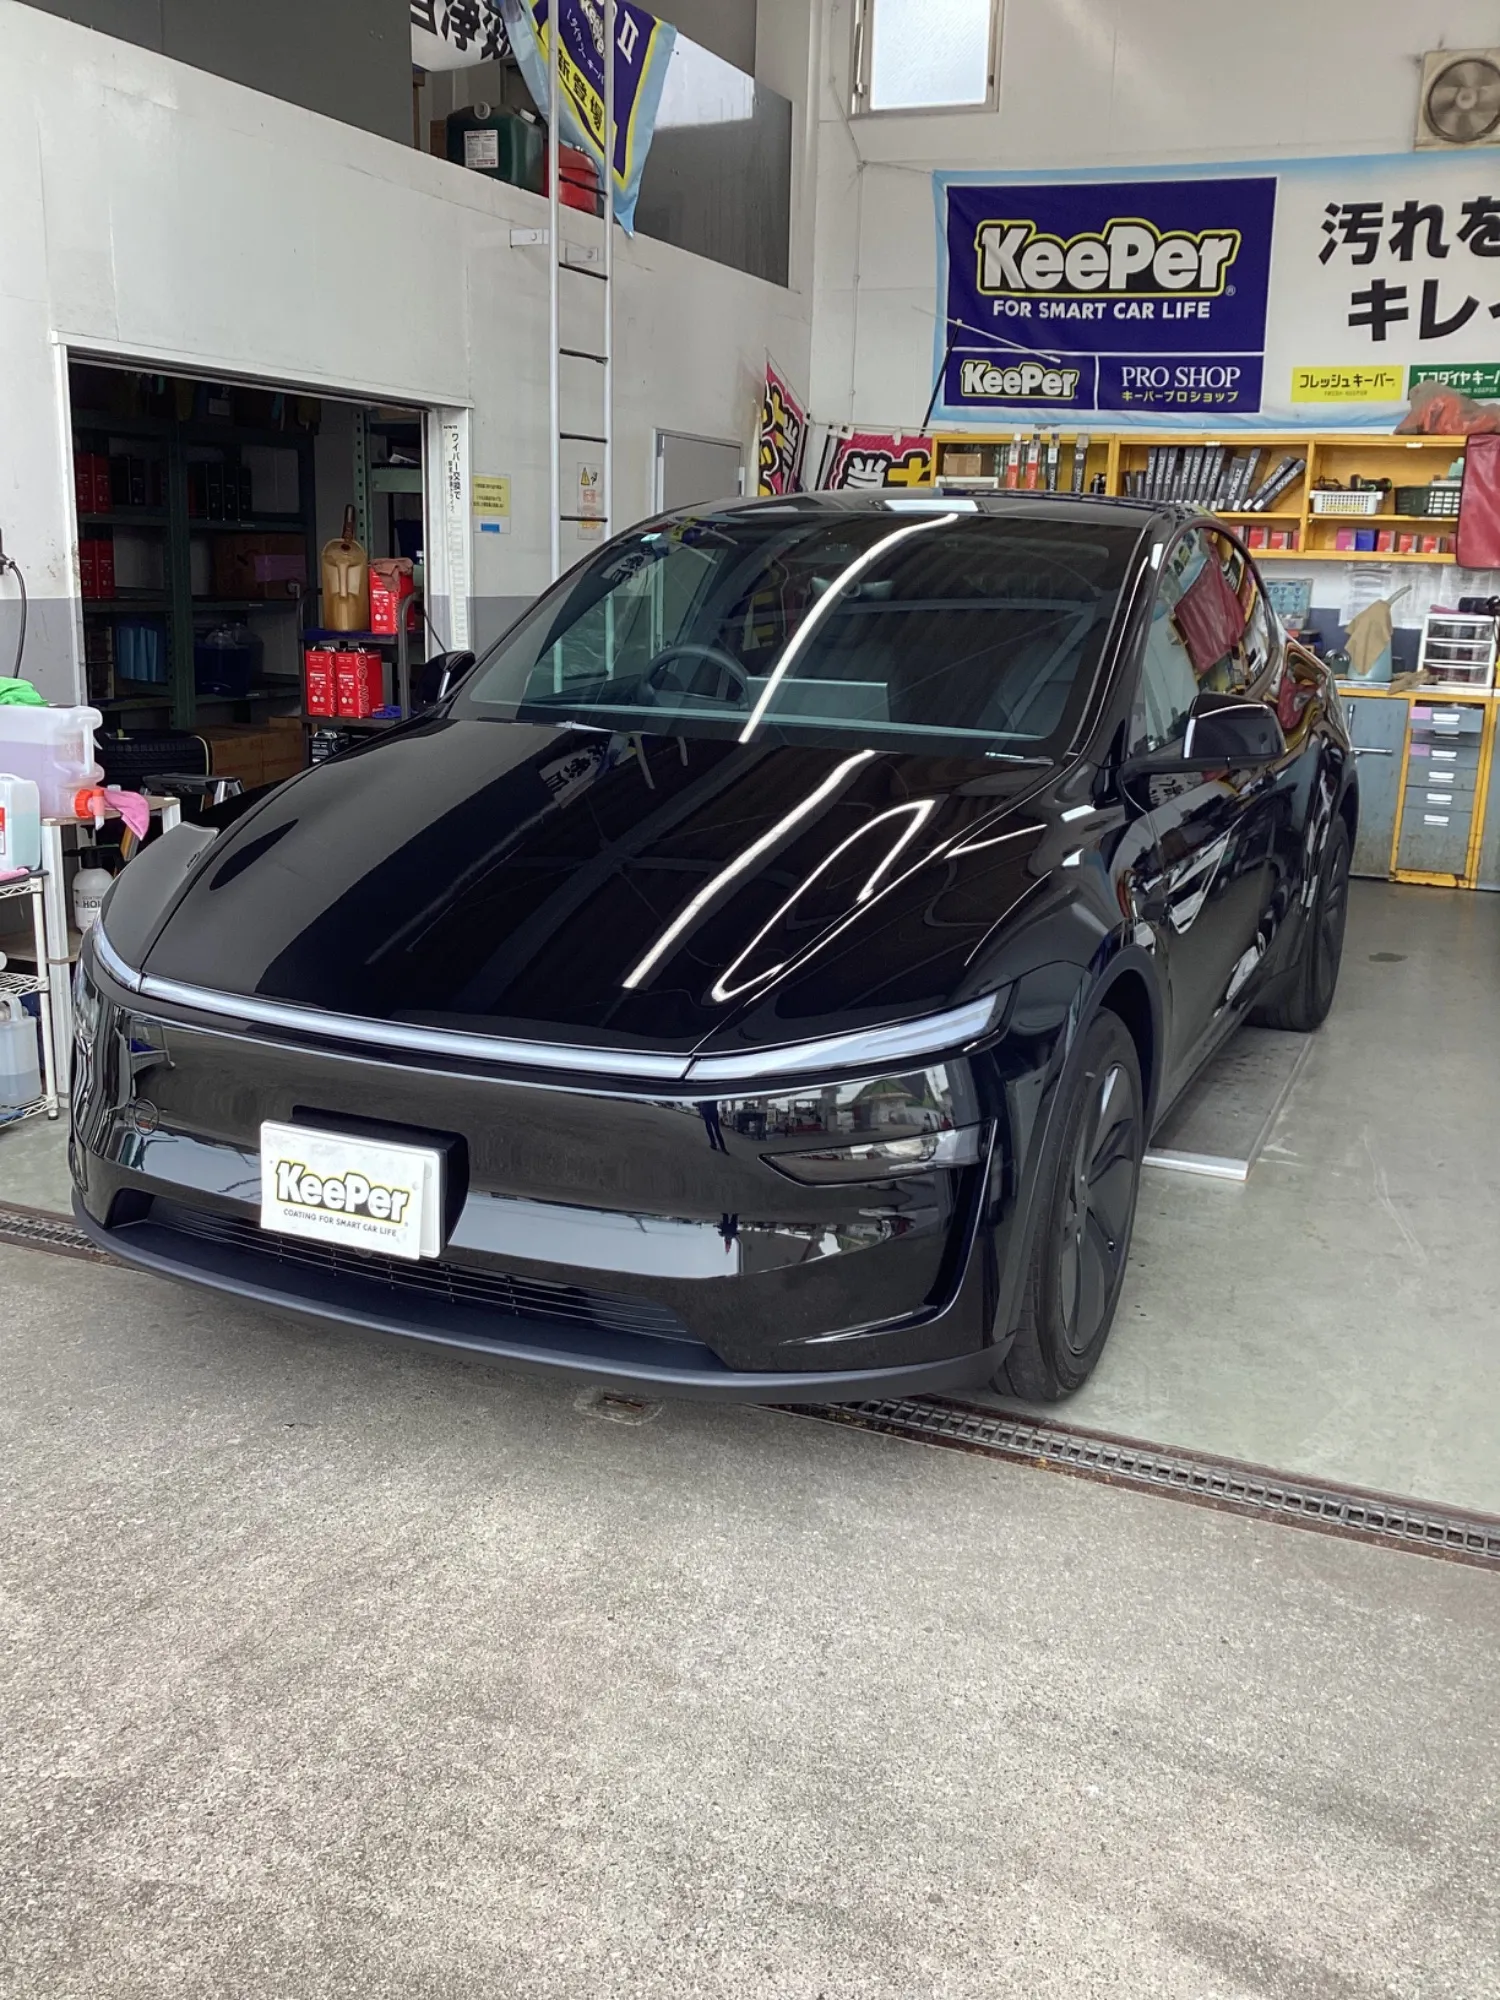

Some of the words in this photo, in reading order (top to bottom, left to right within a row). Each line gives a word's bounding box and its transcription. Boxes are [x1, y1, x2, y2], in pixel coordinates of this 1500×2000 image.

[976, 219, 1240, 296] KeePer
[1318, 195, 1500, 266] 汚れを
[993, 300, 1032, 318] FOR
[1039, 302, 1106, 319] SMART
[1113, 302, 1155, 319] CAR
[1162, 301, 1211, 319] LIFE
[1348, 277, 1500, 342] キレ
[961, 360, 1080, 399] KeePer
[1121, 366, 1170, 388] PRO
[1174, 366, 1241, 388] SHOP
[452, 433, 461, 500] ワイパー交換で
[276, 1160, 410, 1224] KeePer
[283, 1208, 317, 1221] COATING
[319, 1215, 334, 1224] FOR
[336, 1218, 361, 1230] SMART
[362, 1223, 377, 1233] CAR
[379, 1226, 397, 1237] LIFE
